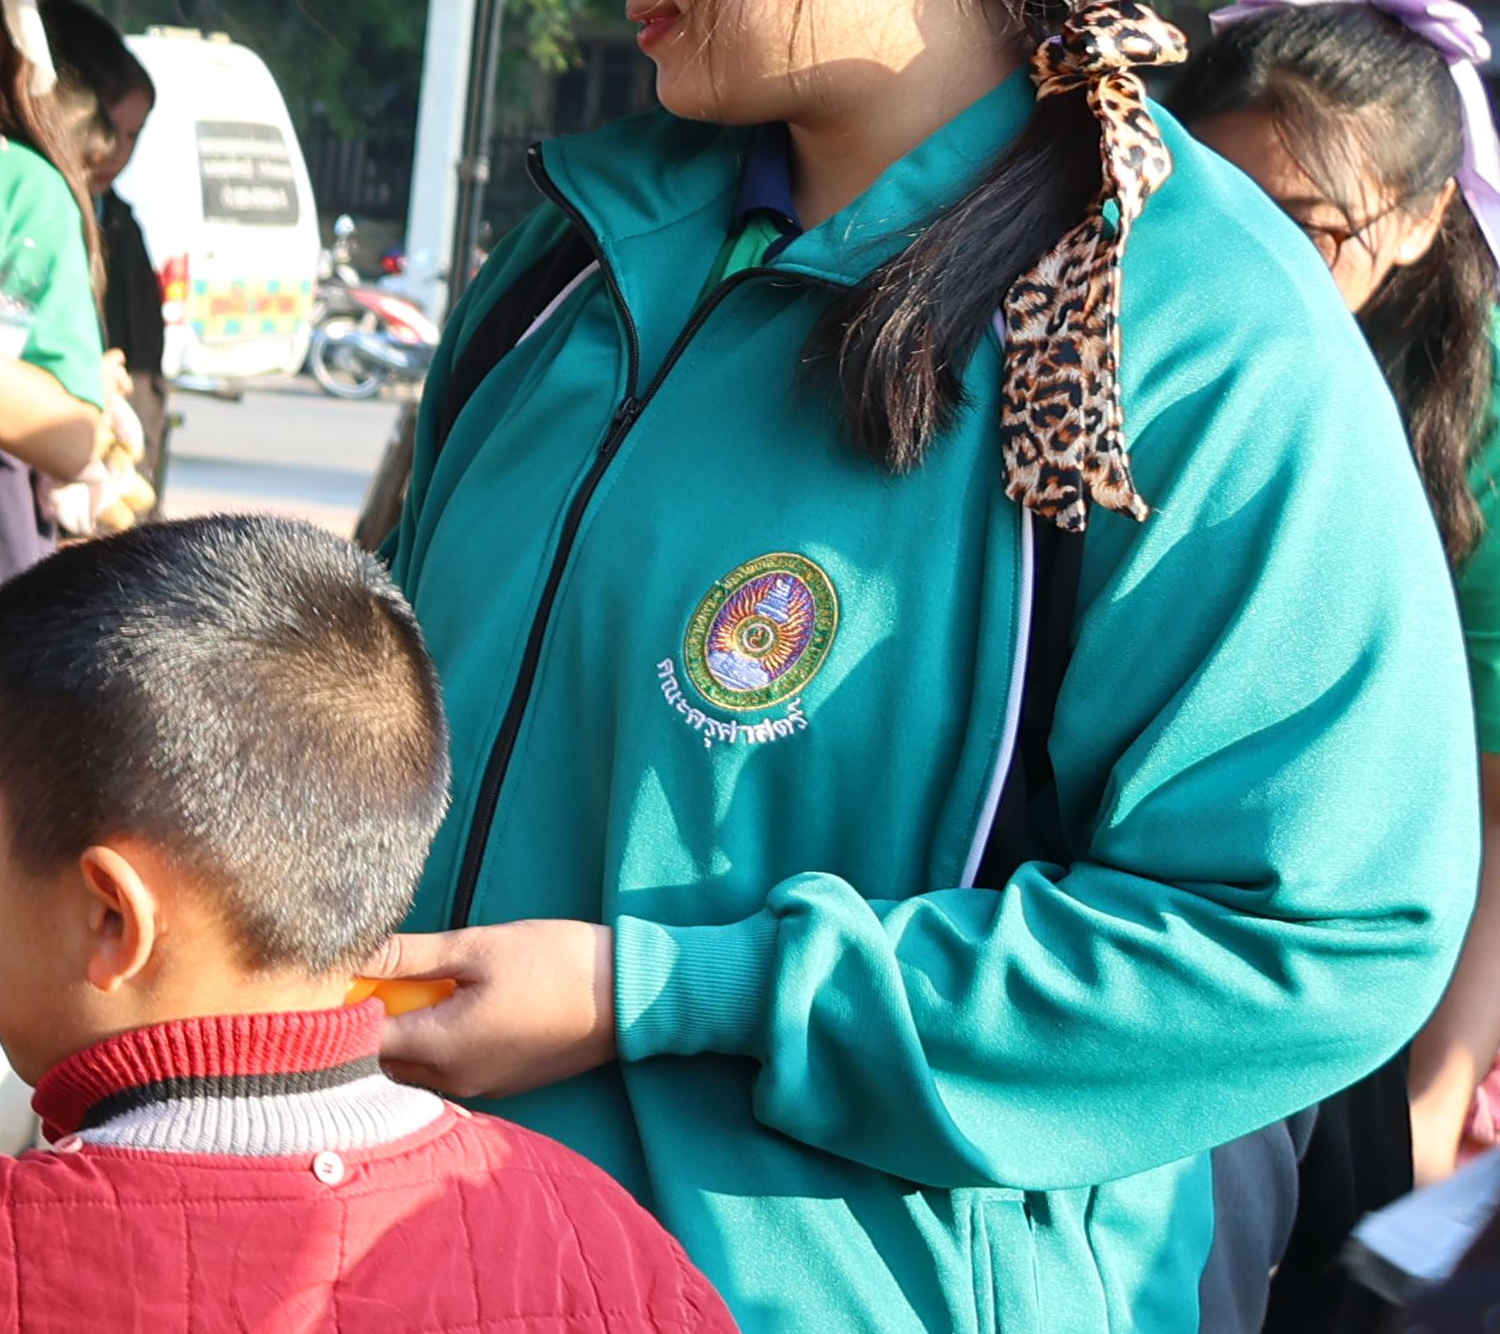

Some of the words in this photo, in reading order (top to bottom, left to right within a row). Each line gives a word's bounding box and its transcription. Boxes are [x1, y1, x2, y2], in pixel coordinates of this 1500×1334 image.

[657, 658, 808, 748] คณะครุศาสตร์
